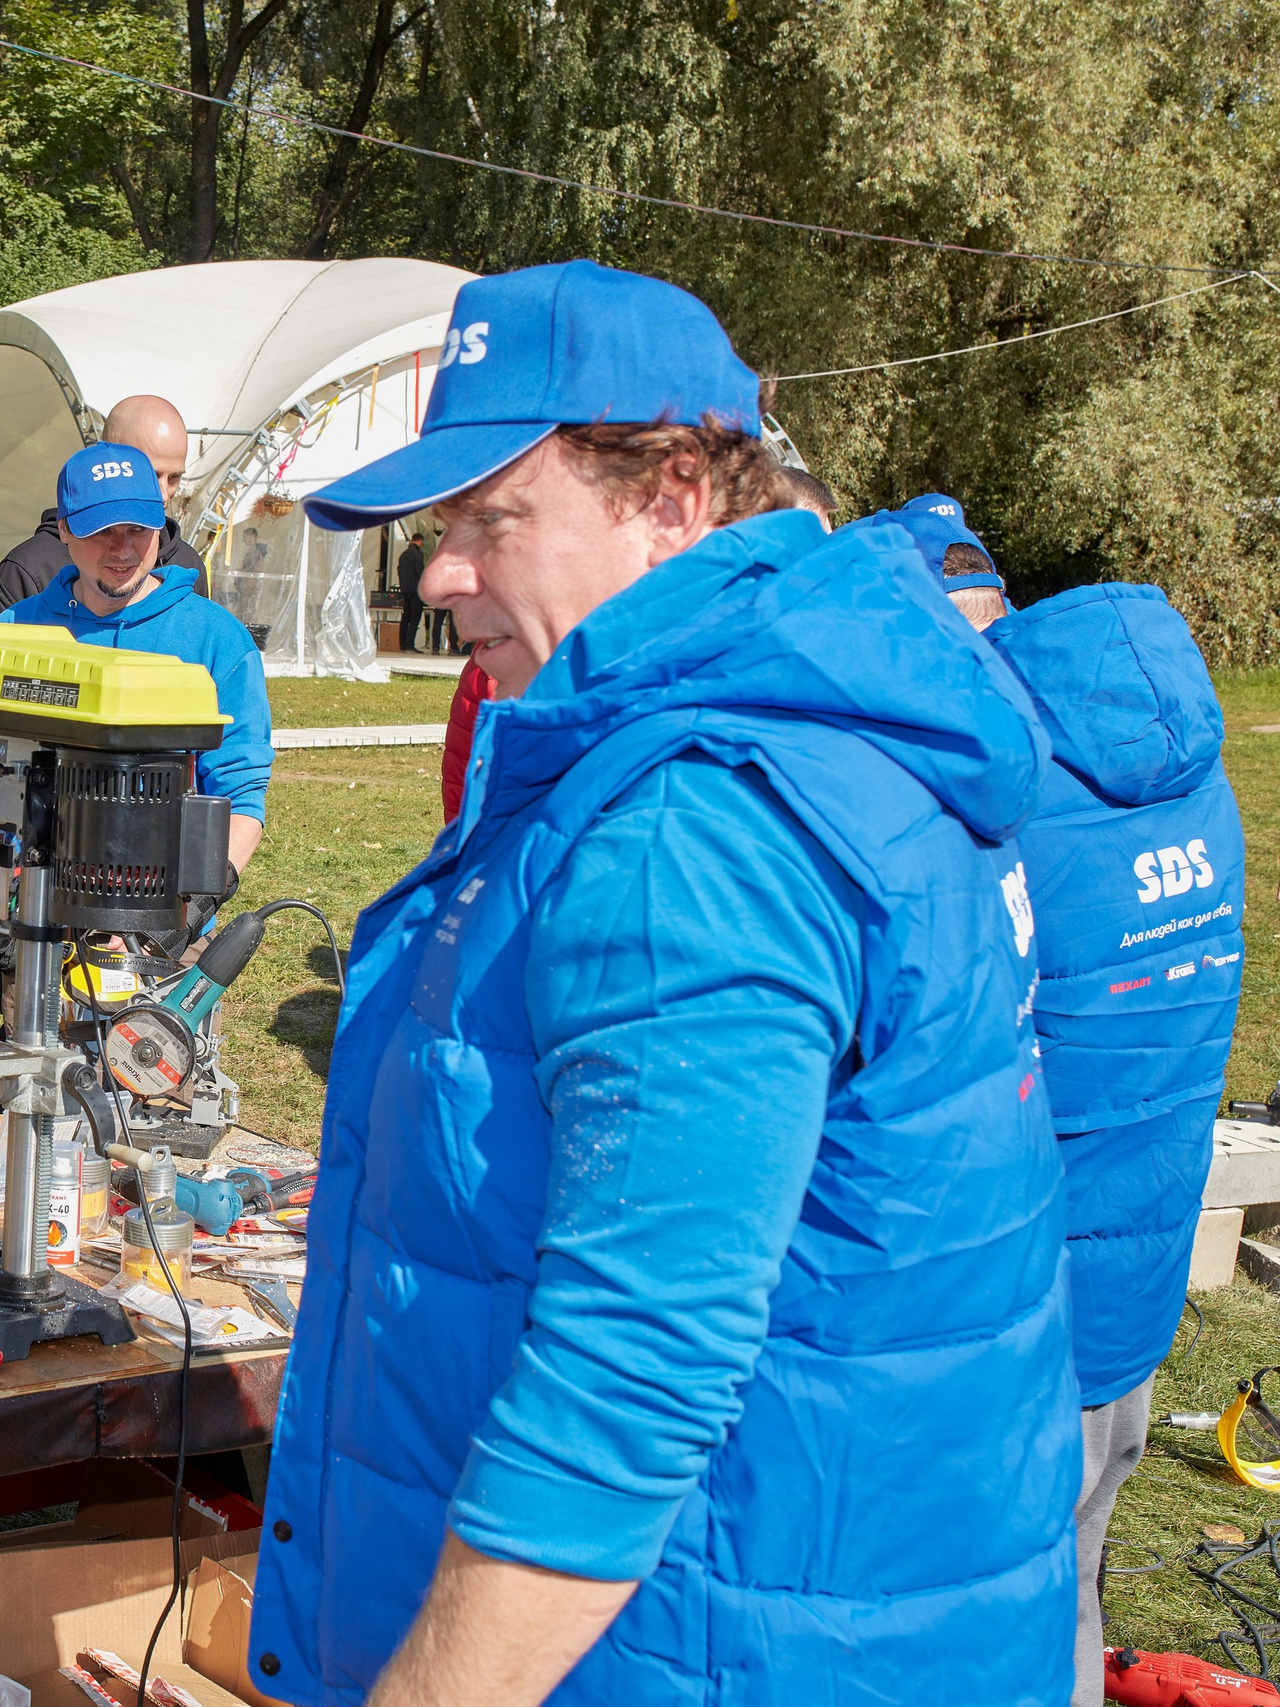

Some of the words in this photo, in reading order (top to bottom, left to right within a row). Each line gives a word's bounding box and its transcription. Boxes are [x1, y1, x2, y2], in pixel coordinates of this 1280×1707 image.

[91, 461, 134, 481] SDS
[1133, 838, 1215, 904] SDS
[1119, 932, 1144, 949] Для
[1145, 918, 1177, 941] людей
[1177, 916, 1194, 931] как
[1195, 911, 1212, 928] для
[1166, 964, 1197, 981] Kranz
[1109, 976, 1152, 994] REXANT
